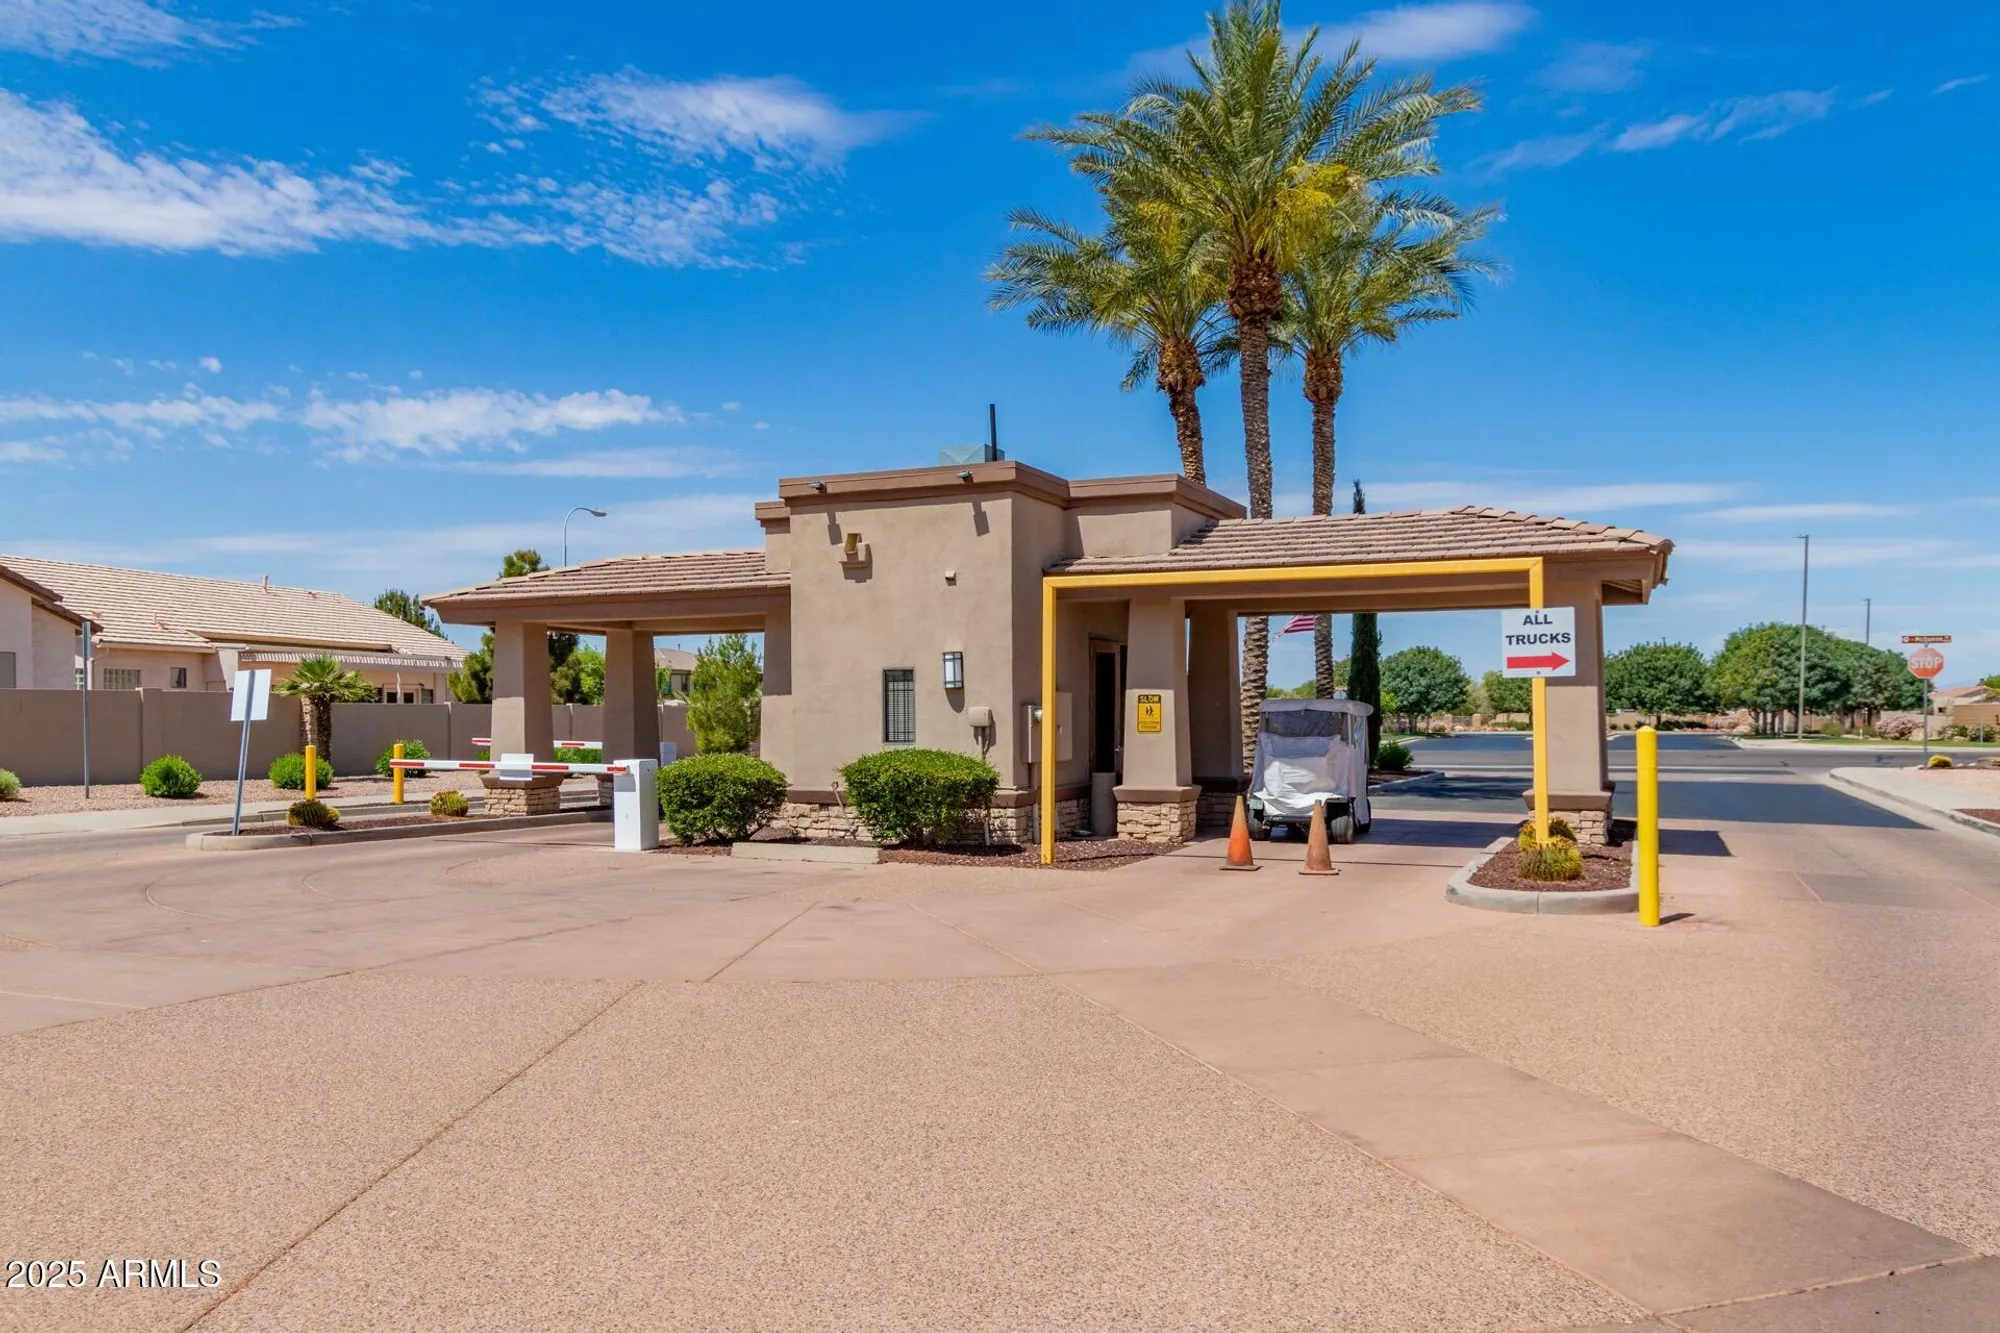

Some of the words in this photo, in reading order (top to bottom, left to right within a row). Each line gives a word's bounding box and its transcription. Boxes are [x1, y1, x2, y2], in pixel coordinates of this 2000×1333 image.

[1523, 614, 1553, 625] ALL
[1505, 632, 1571, 645] TRUCKS
[1911, 657, 1941, 668] STOP
